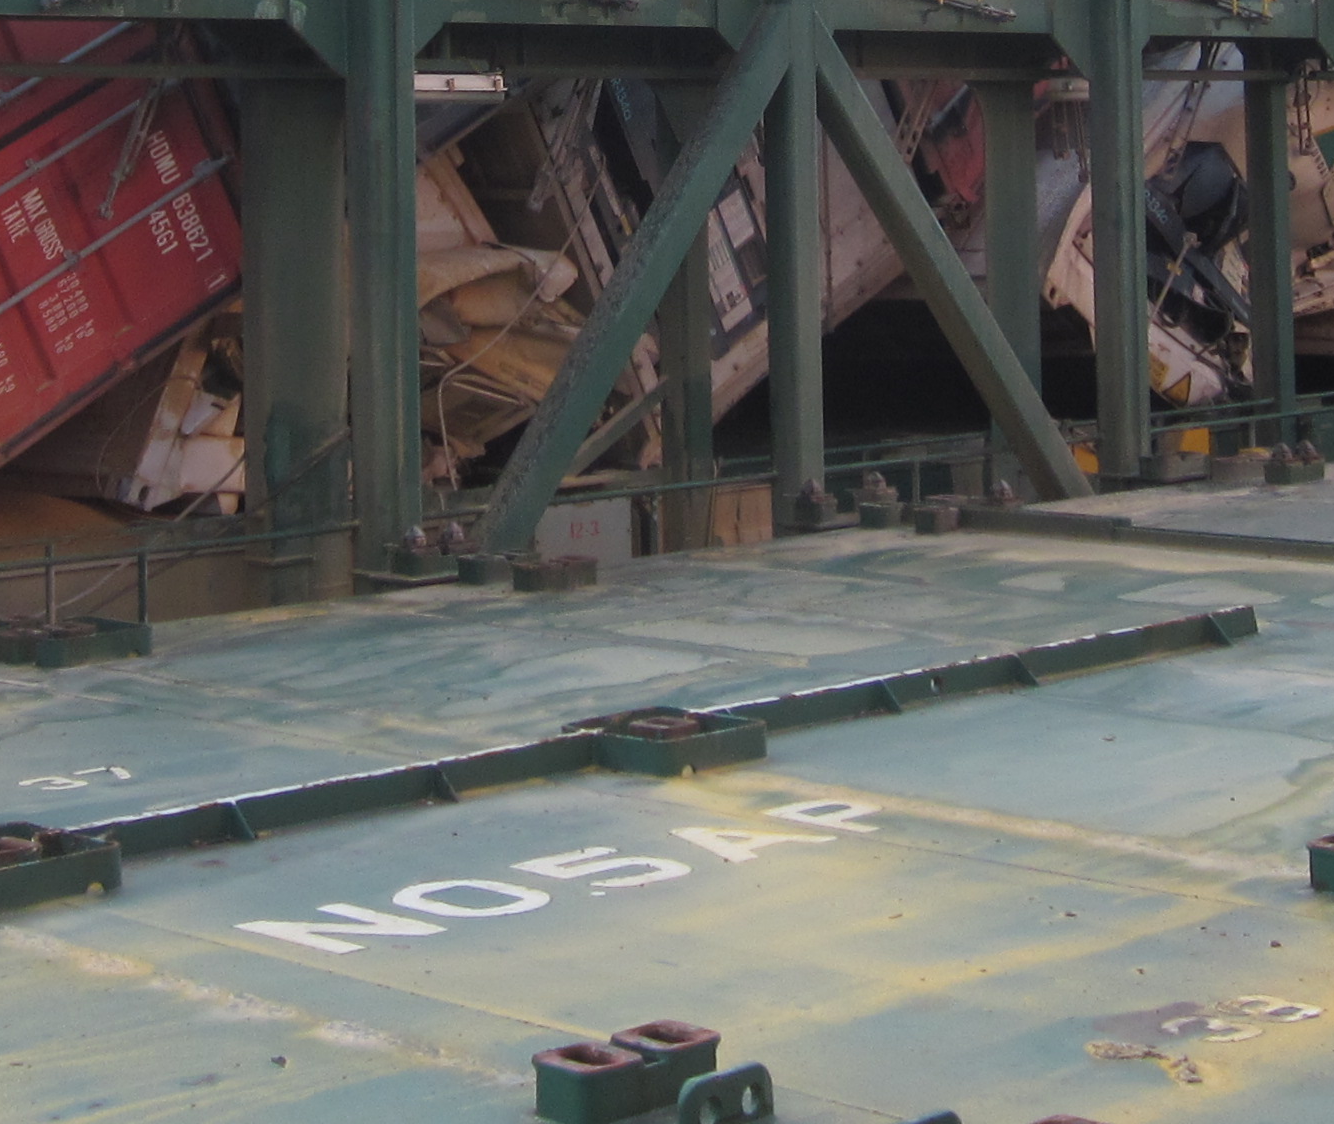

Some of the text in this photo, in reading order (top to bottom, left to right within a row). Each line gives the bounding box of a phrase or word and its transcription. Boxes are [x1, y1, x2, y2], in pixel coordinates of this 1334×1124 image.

[0, 201, 29, 242] TARE
[21, 187, 47, 222] MAX
[34, 217, 63, 260] GROSS
[145, 130, 180, 186] HDMU
[172, 193, 210, 261] 638621
[148, 208, 177, 255] 45G1
